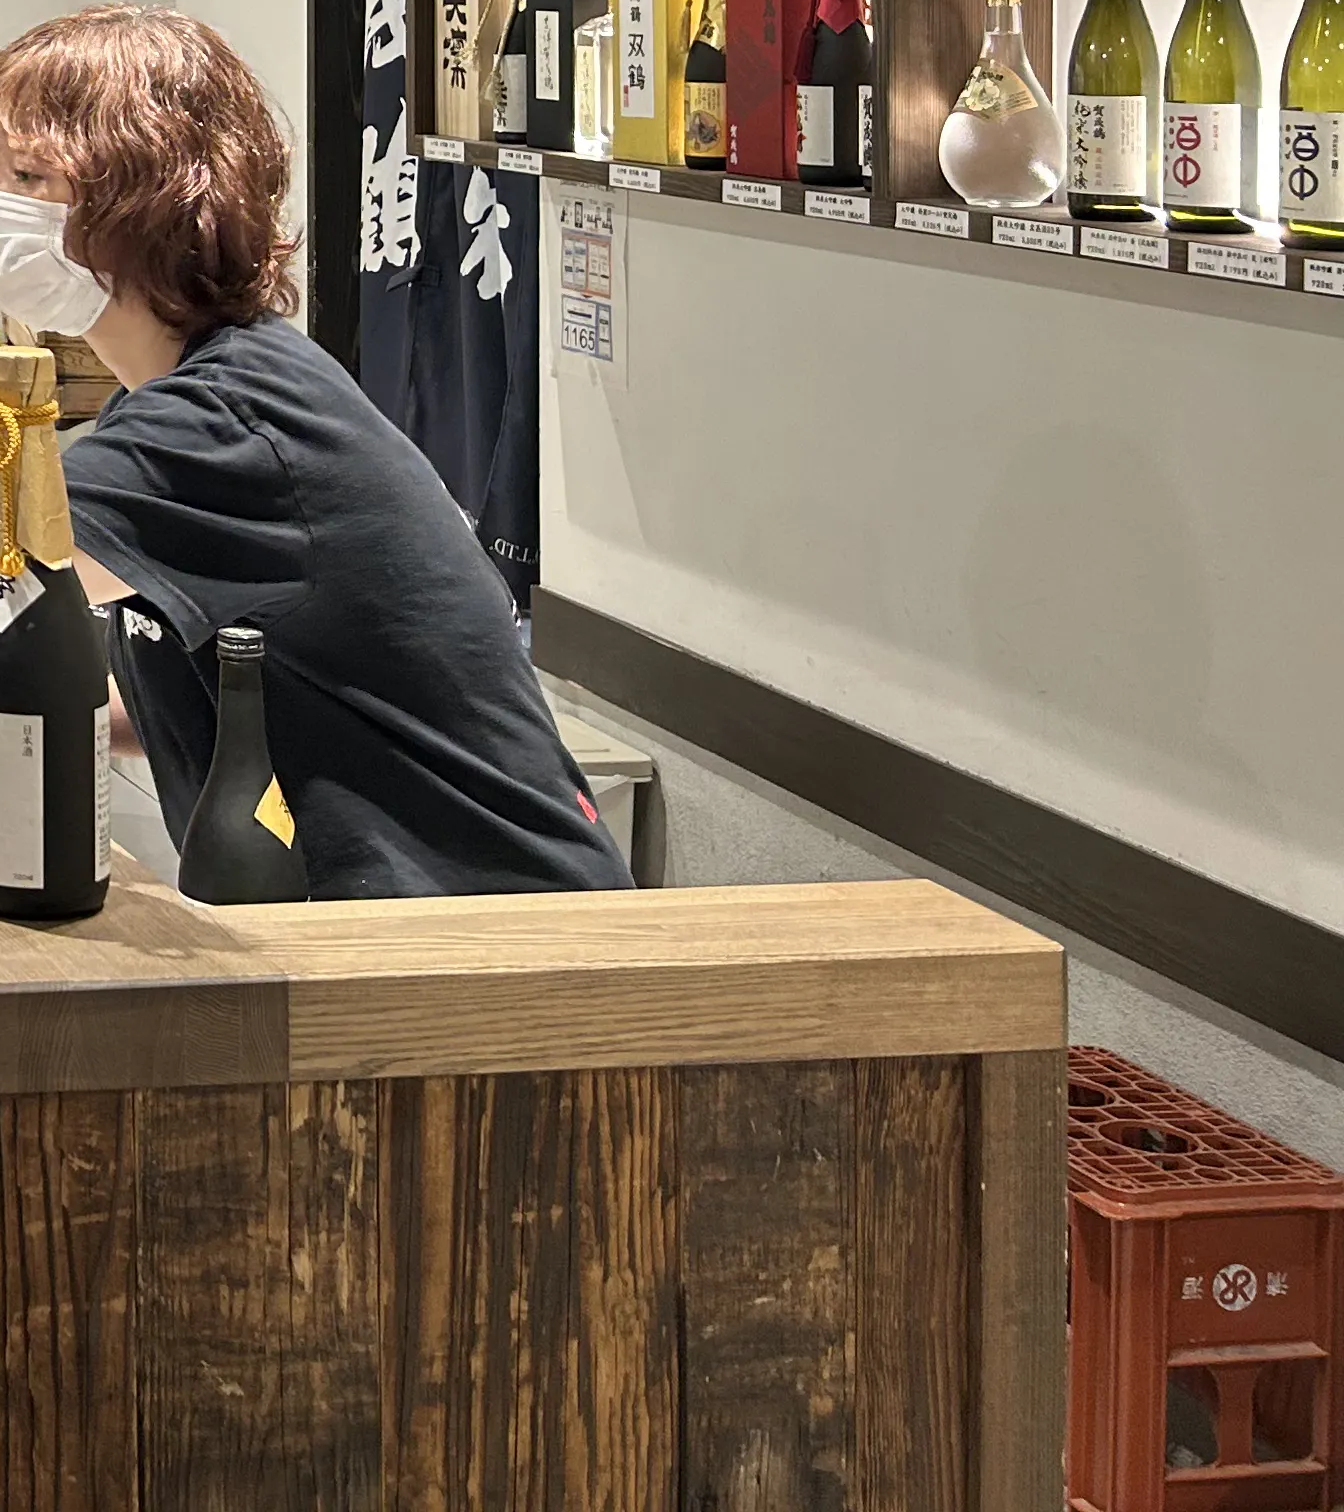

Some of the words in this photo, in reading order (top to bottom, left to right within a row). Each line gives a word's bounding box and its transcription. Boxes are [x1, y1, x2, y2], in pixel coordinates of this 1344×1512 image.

[627, 33, 646, 90] 双鶴
[1093, 104, 1106, 139] 賀茂鶴
[564, 324, 596, 351] 1165
[22, 724, 34, 758] 日本酒
